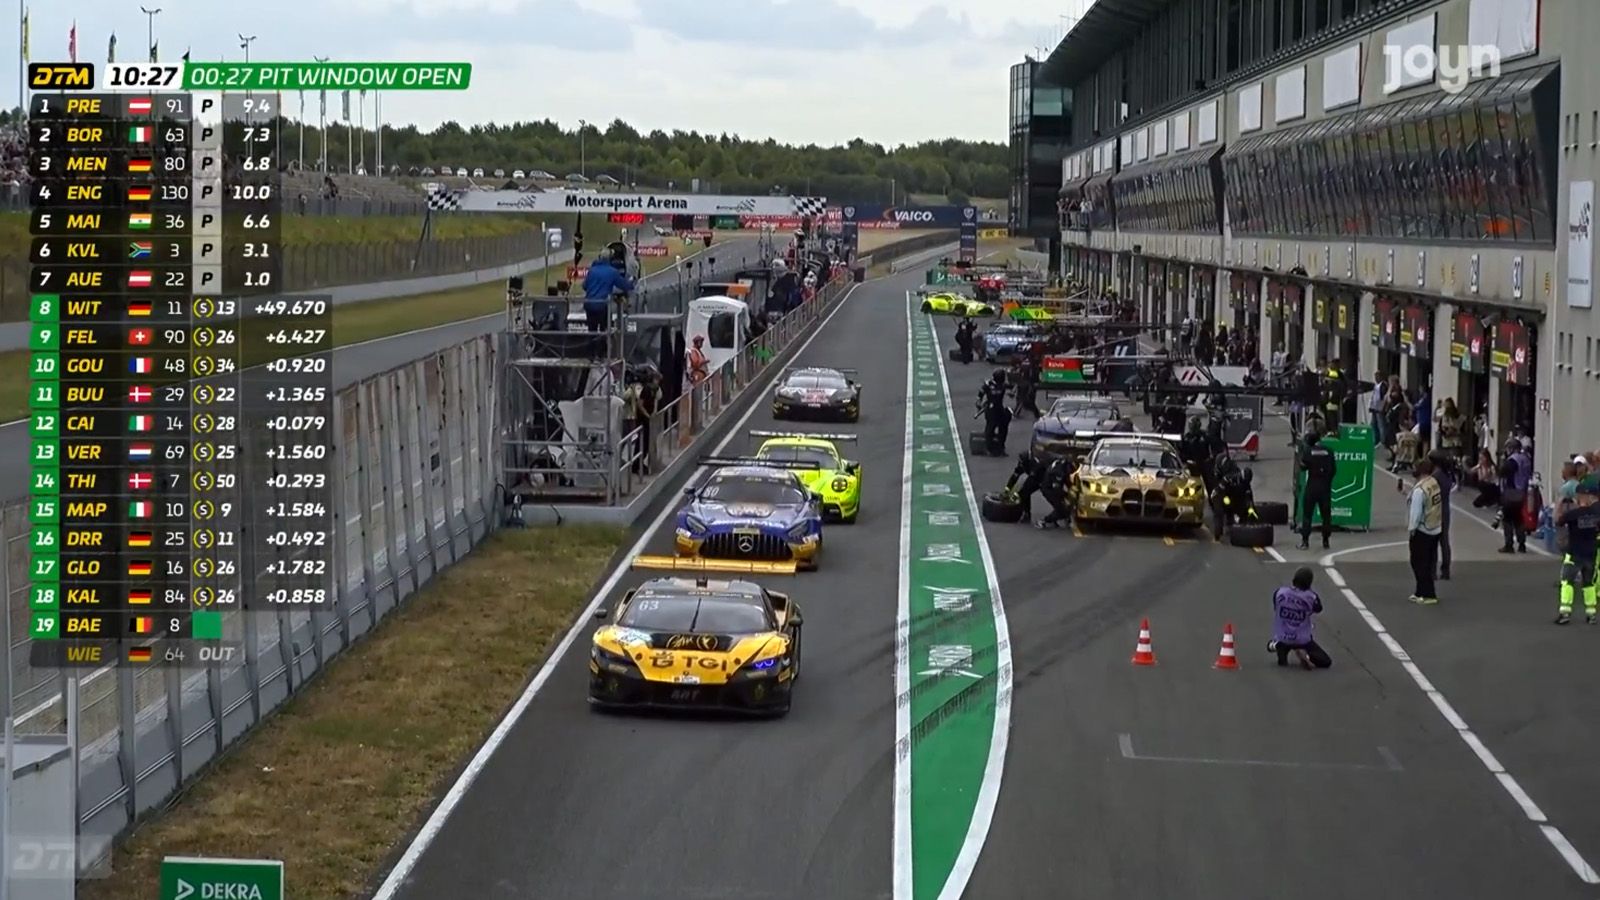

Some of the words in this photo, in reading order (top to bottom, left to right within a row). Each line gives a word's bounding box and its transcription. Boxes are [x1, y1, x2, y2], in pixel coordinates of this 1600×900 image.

[565, 195, 642, 211] Motorsport
[647, 196, 688, 209] Arena
[1333, 452, 1368, 461] EFFLER
[703, 485, 720, 497] 80
[638, 600, 660, 612] 63
[200, 882, 262, 900] DEKRA
